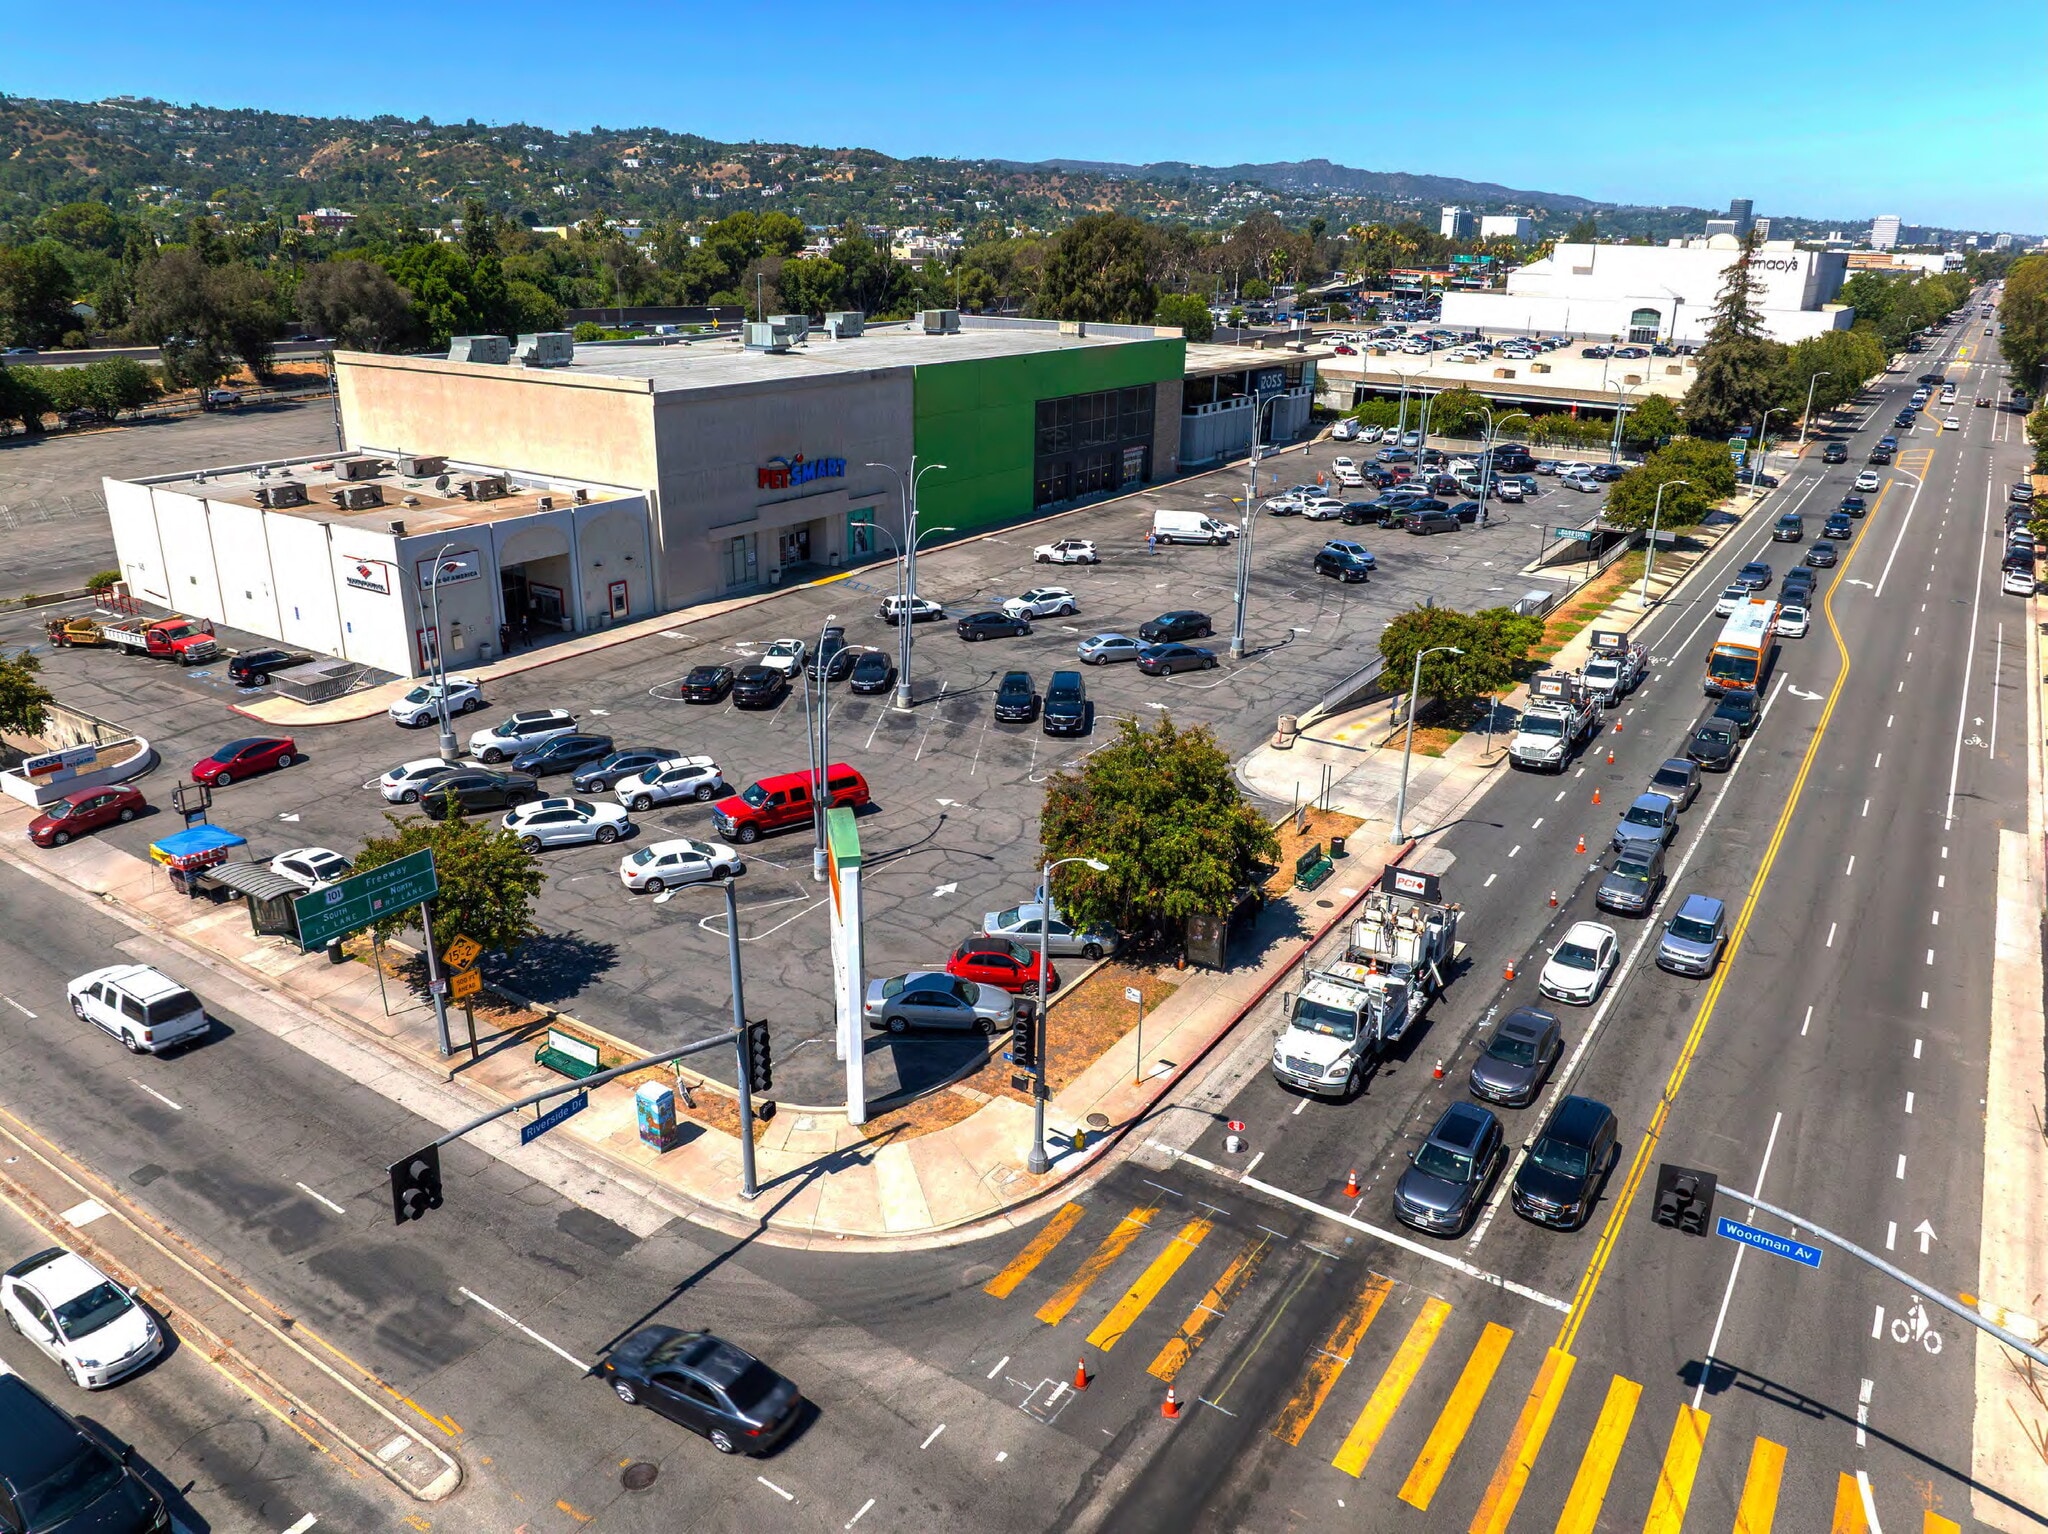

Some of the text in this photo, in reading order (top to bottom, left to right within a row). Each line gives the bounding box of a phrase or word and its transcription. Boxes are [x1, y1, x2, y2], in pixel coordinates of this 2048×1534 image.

[1752, 257, 1799, 274] macy's
[1260, 373, 1283, 390] ROSS
[758, 457, 847, 490] PETSMART
[425, 578, 442, 587] BAK
[29, 755, 61, 769] ROSS
[366, 865, 407, 887] Freeway
[1397, 877, 1416, 888] PCI
[327, 889, 342, 902] 101
[401, 885, 423, 901] LANE
[315, 912, 357, 935] LT LANE
[457, 982, 476, 993] AHEAD
[526, 1098, 583, 1138] Riverside Dr
[1726, 1223, 1813, 1260] Woodman Av
